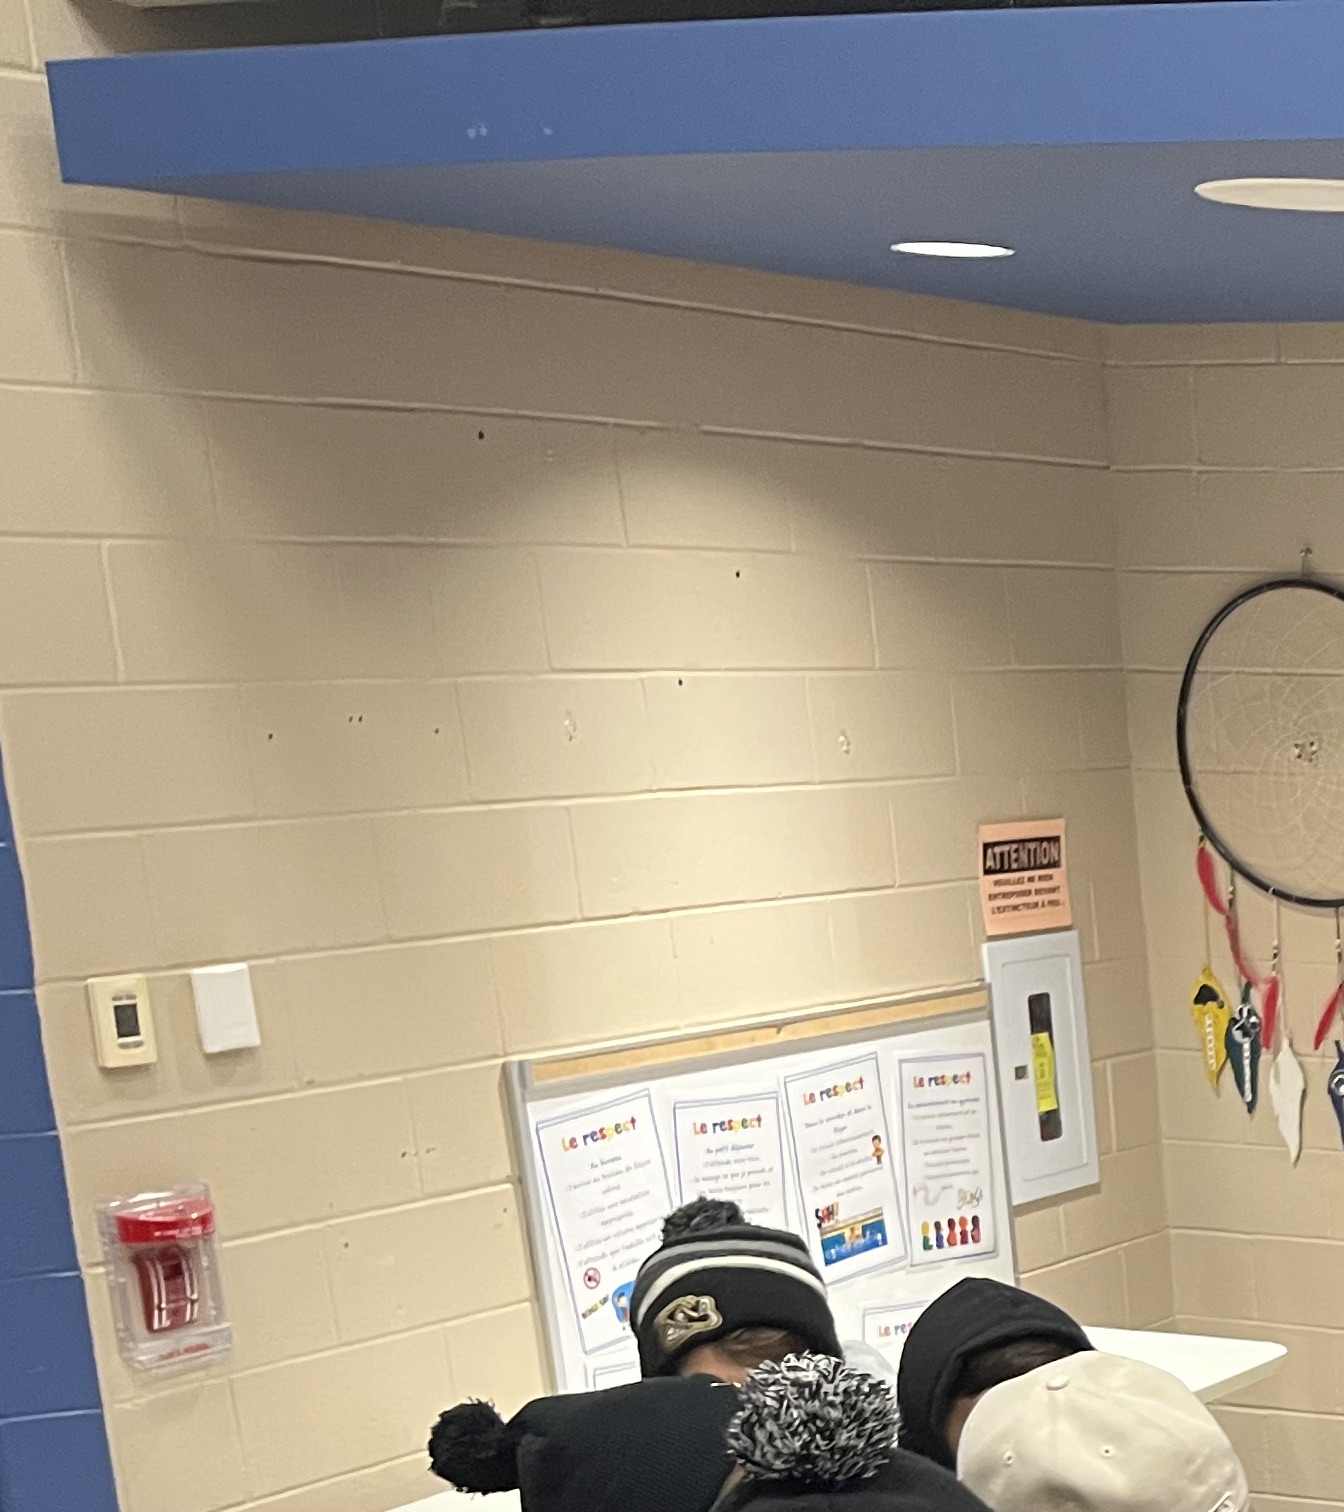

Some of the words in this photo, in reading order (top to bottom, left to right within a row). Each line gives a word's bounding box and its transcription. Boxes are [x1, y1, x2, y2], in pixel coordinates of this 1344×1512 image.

[985, 840, 1060, 870] ATTENTION
[820, 1076, 864, 1101] respect
[928, 1071, 971, 1087] respect
[561, 1137, 578, 1151] Le
[582, 1116, 637, 1146] respect
[693, 1122, 707, 1135] Le
[712, 1115, 762, 1134] respect
